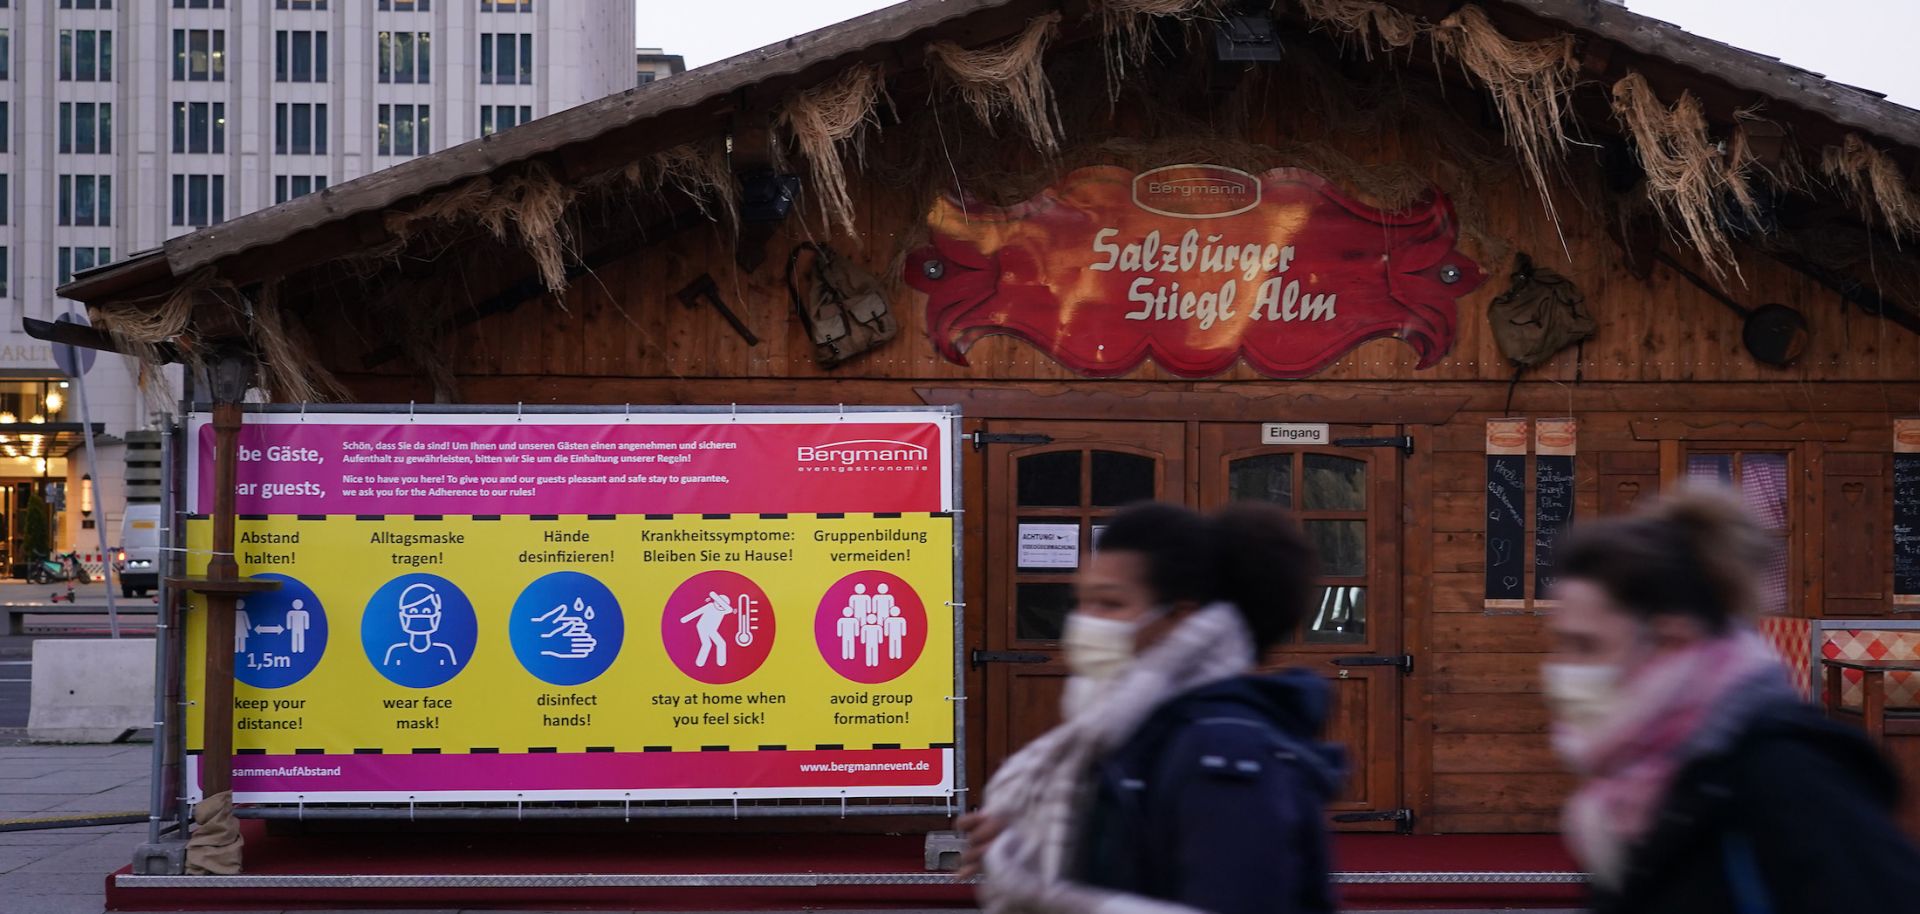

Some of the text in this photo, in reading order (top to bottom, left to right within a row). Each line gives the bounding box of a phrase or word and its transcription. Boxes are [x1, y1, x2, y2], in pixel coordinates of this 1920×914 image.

[1125, 276, 1337, 331] Stiegl Alm
[1270, 427, 1320, 440] Eingang
[342, 441, 373, 452] Schön,
[375, 442, 396, 450] dass
[398, 442, 411, 450] Sie
[413, 442, 425, 450] da
[427, 442, 450, 450] sind!
[471, 442, 496, 450] Ihnen
[499, 442, 516, 450] und
[557, 442, 589, 451] Gästen
[590, 442, 616, 450] einen
[618, 441, 677, 452] angenehmen
[679, 441, 697, 450] und
[699, 441, 736, 449] sicheren
[267, 446, 324, 465] Gäste,
[343, 453, 392, 463] Aufenthalt
[406, 454, 473, 465] gewährleisten,
[475, 454, 502, 463] bitten
[504, 454, 519, 463] wir
[521, 454, 535, 463] Sie
[554, 454, 568, 463] die
[570, 453, 619, 465] Einhaltung
[621, 455, 655, 463] unserer
[657, 453, 691, 465] Regeln!
[798, 465, 928, 473] eventgastronomie
[343, 473, 729, 486] Nice to have you here! To give you and our guests pleasant and safe stay to guarantee,
[262, 480, 326, 499] guests,
[342, 487, 535, 498] we ask you for the Adherence to our rules!
[241, 530, 299, 544] Abstand
[371, 531, 464, 547] Alltagsmaske
[545, 529, 589, 543] Hände
[642, 529, 794, 544] Krankheitssymptome:
[814, 528, 927, 545] Gruppenbildung
[244, 551, 296, 565] halten!
[392, 551, 443, 566] tragen!
[519, 550, 614, 563] desinfizieren!
[644, 548, 792, 563] Bleiben Sie zu Hause!
[831, 548, 910, 562] vermeiden!
[247, 652, 291, 671] 1,5m
[234, 696, 306, 712] keep your
[383, 695, 452, 709] wear face
[537, 693, 597, 706] disinfect
[652, 691, 785, 708] stay at home when
[831, 691, 912, 707] avoid group
[237, 716, 302, 730] distance!
[397, 716, 438, 729] mask!
[544, 713, 590, 727] hands!
[673, 711, 764, 728] you feel sick!
[834, 711, 908, 725] formation!
[231, 765, 341, 778] sammenAufAbstand
[800, 760, 929, 774] www.bergmannevent.de
